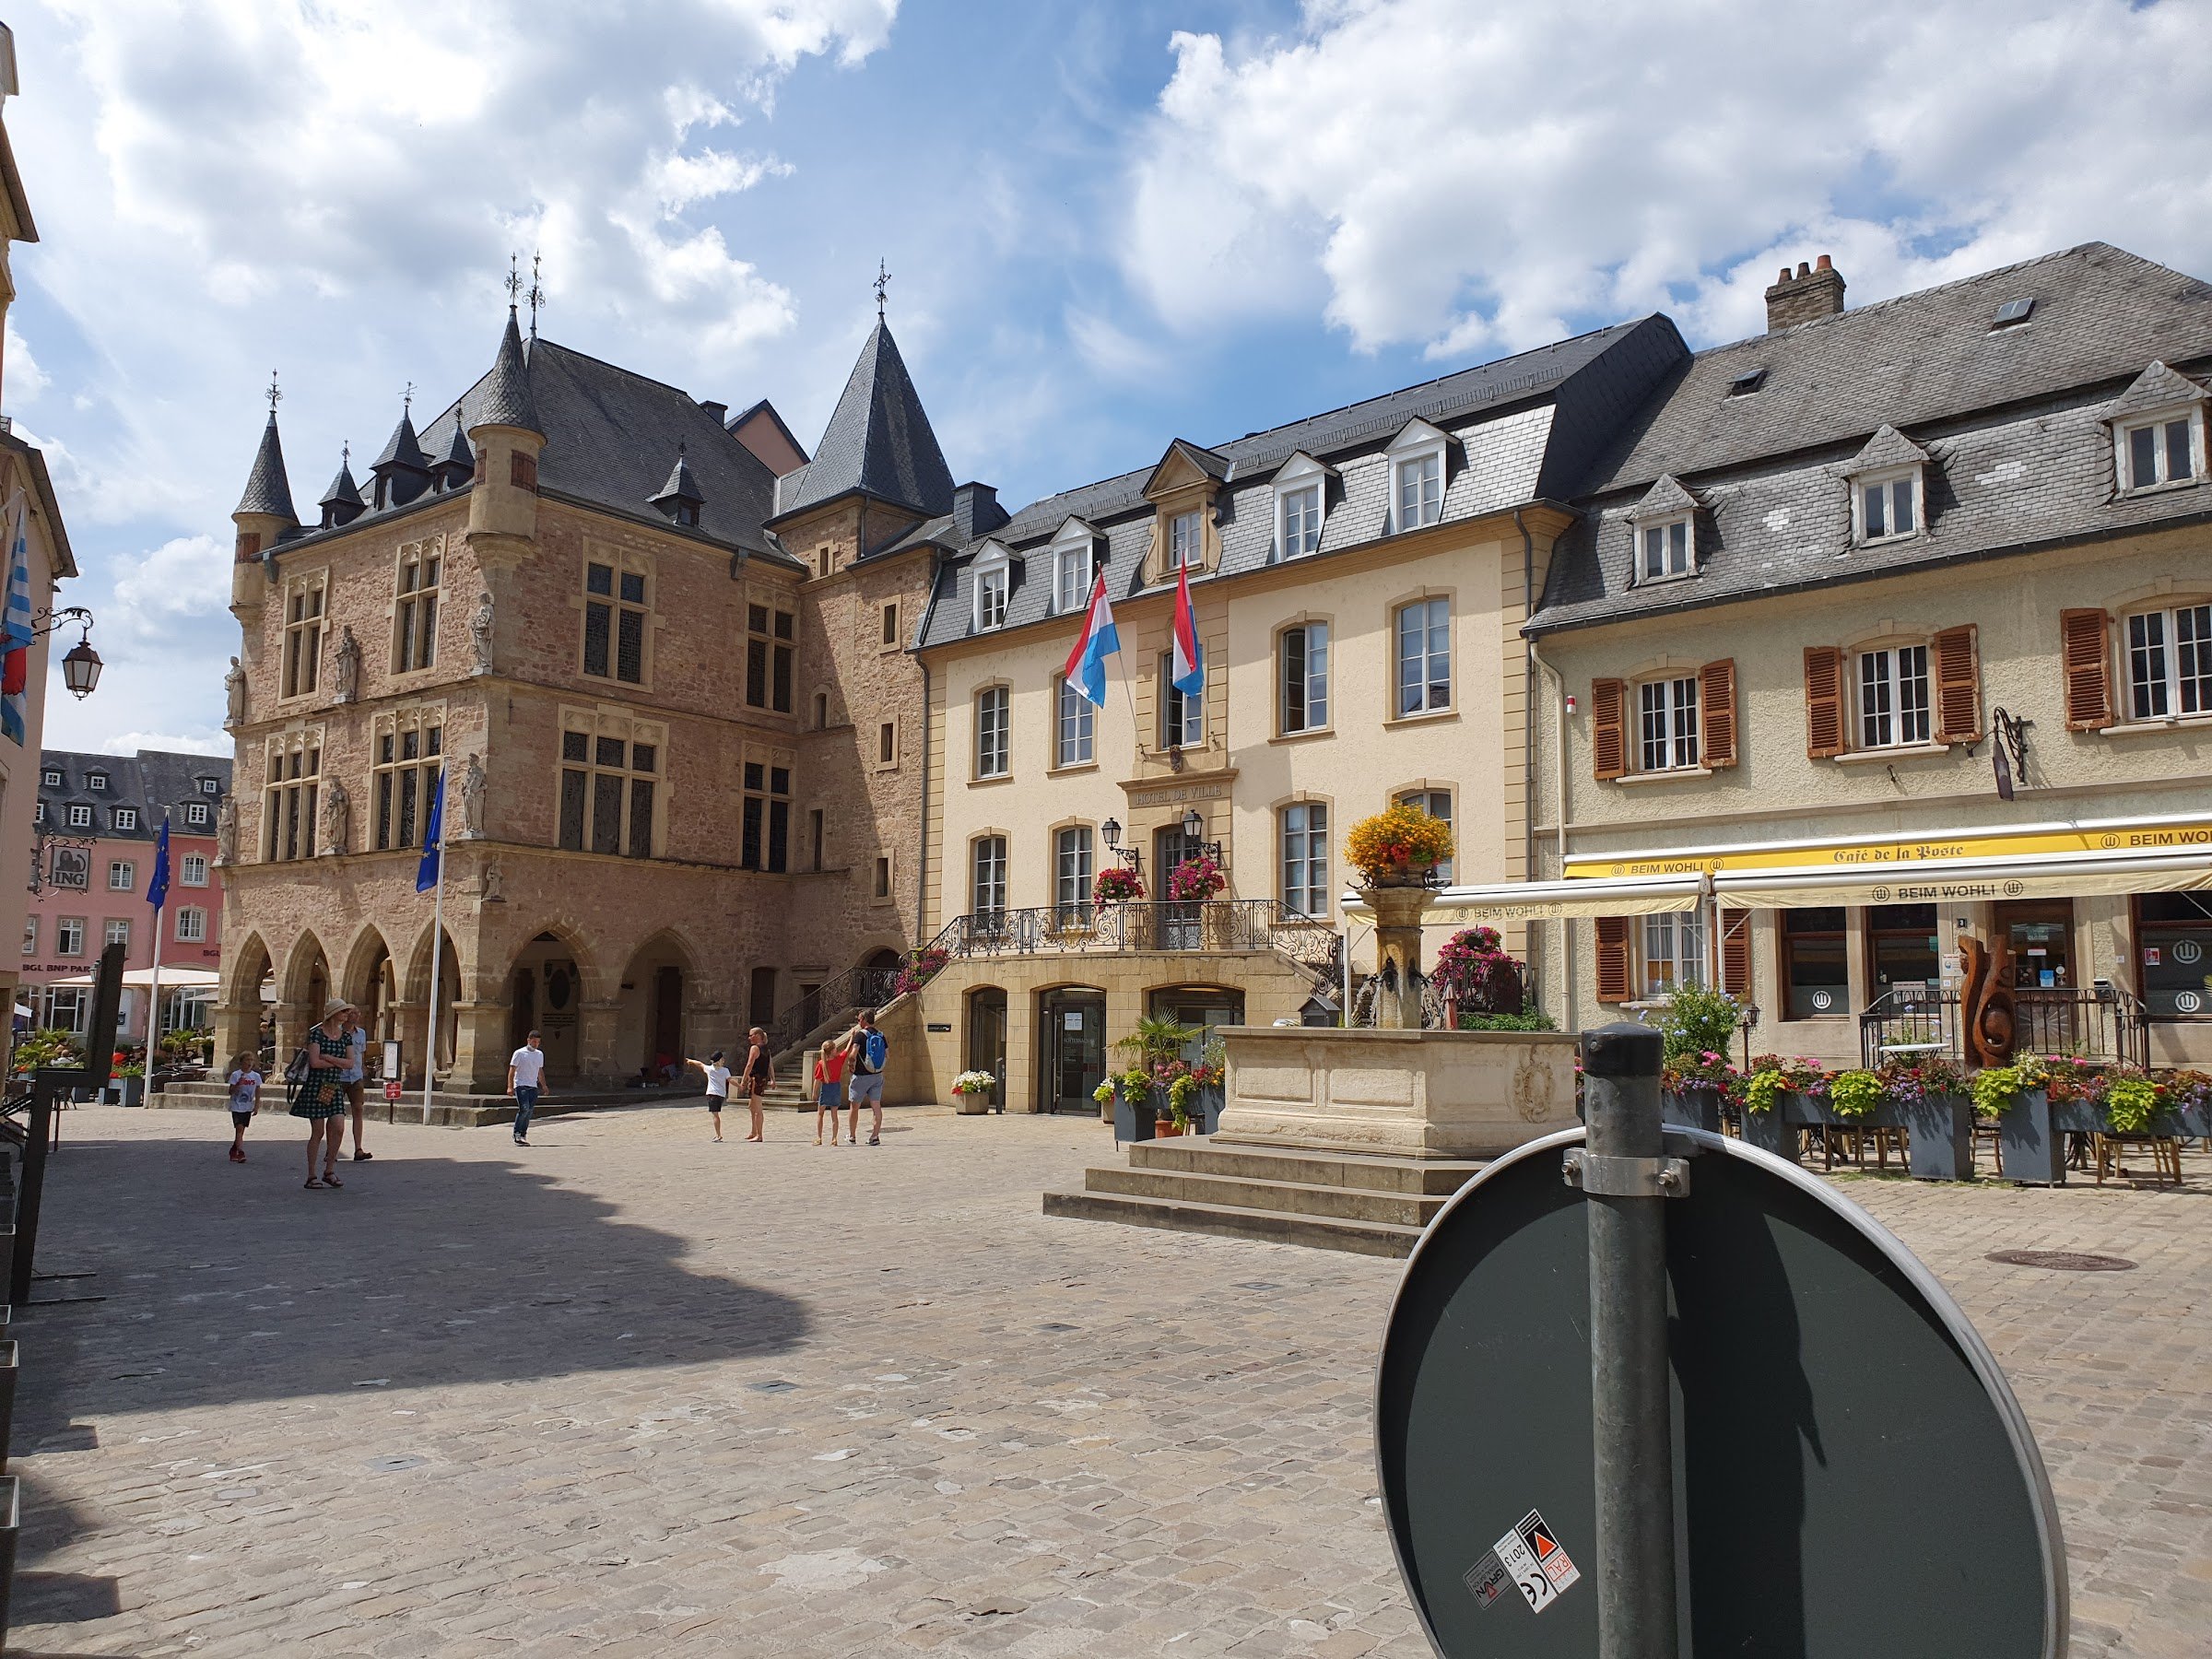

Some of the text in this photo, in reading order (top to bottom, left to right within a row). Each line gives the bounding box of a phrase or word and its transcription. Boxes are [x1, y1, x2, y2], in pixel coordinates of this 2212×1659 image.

[1172, 789, 1187, 801] DE
[1190, 784, 1222, 798] VILLE
[2130, 832, 2173, 846] BEIM
[1833, 844, 1965, 864] Café de la Poste
[1630, 865, 1660, 875] BEIM
[1663, 862, 1703, 873] WOHLI
[54, 871, 85, 886] ING
[1898, 887, 1936, 900] BEIM
[1941, 884, 1995, 898] WOHLI
[1475, 908, 1502, 918] BEIM
[1505, 904, 1543, 917] WOHLI
[46, 964, 68, 972] BNP
[70, 965, 90, 973] PAR
[1504, 1544, 1526, 1568] 2013
[1547, 1556, 1570, 1575] RAL
[1520, 1572, 1548, 1606] CE
